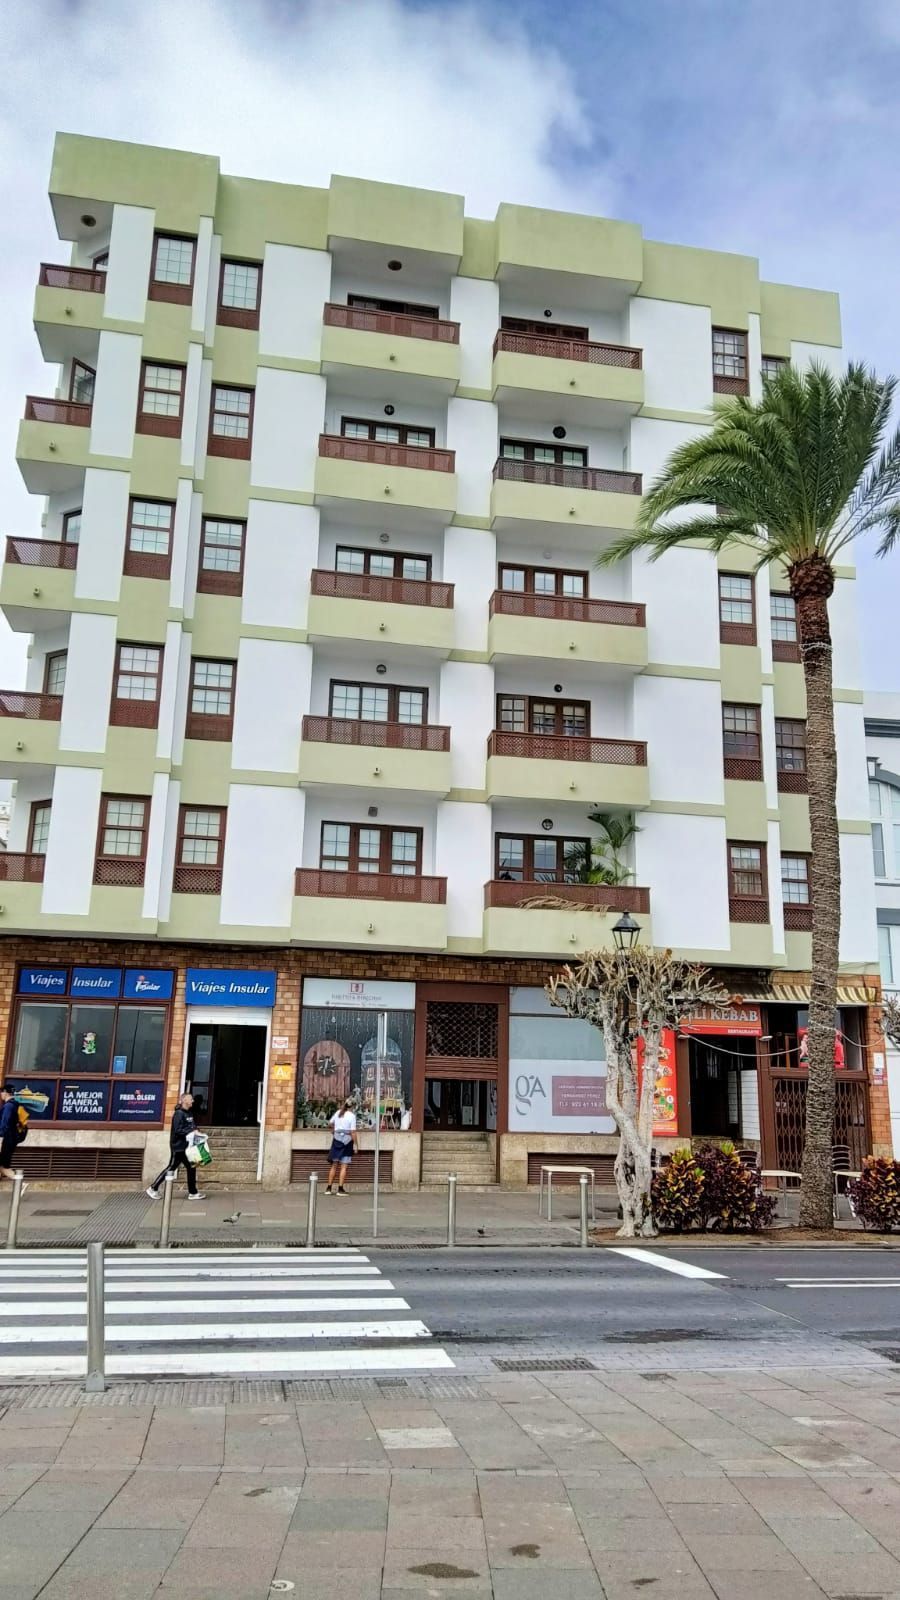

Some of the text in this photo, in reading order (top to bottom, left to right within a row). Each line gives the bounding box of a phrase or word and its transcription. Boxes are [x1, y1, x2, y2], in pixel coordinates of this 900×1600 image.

[30, 974, 113, 988] Viajes Insular
[191, 981, 270, 995] Viajes Insular
[711, 1008, 758, 1022] KEBAB
[63, 1091, 103, 1099] LA MEJOR
[75, 1106, 103, 1114] VIAJAR
